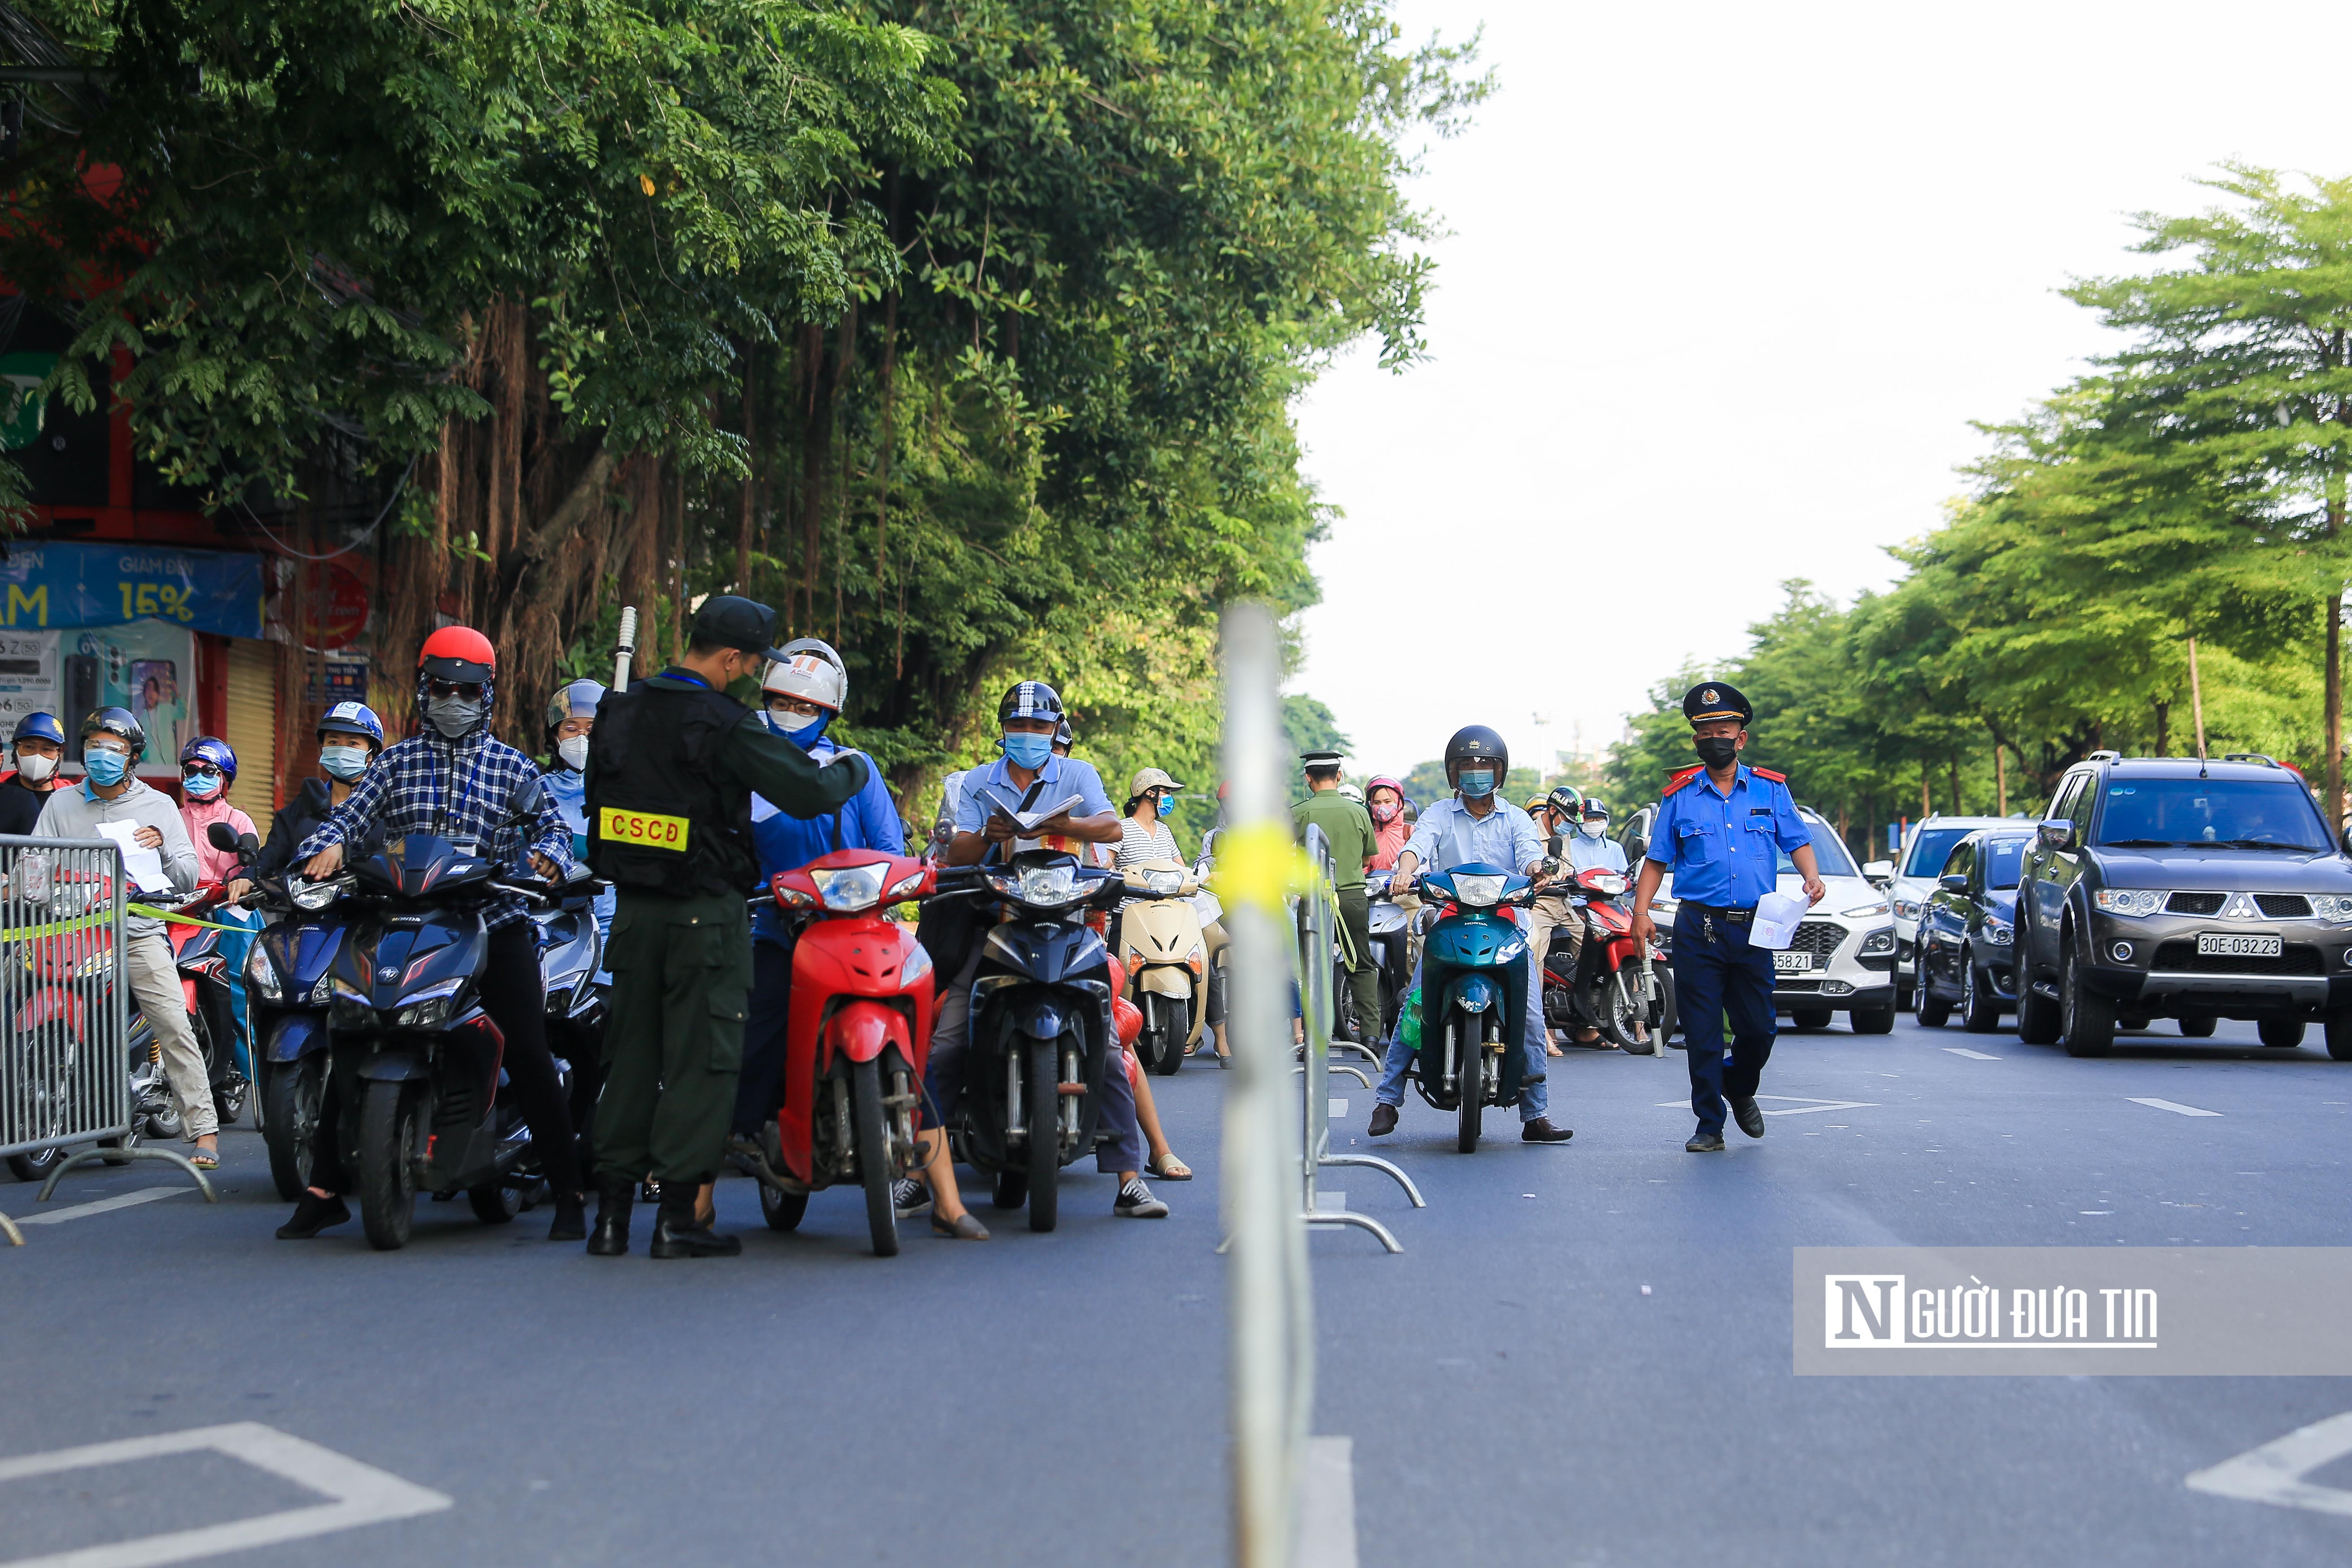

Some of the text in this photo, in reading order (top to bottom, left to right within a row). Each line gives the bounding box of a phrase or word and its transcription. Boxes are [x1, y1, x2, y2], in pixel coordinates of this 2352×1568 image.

[118, 582, 194, 622] 15%
[1551, 791, 1569, 806] ITALIA
[612, 815, 678, 843] CSCĐ
[2200, 938, 2279, 955] 30E-032.23
